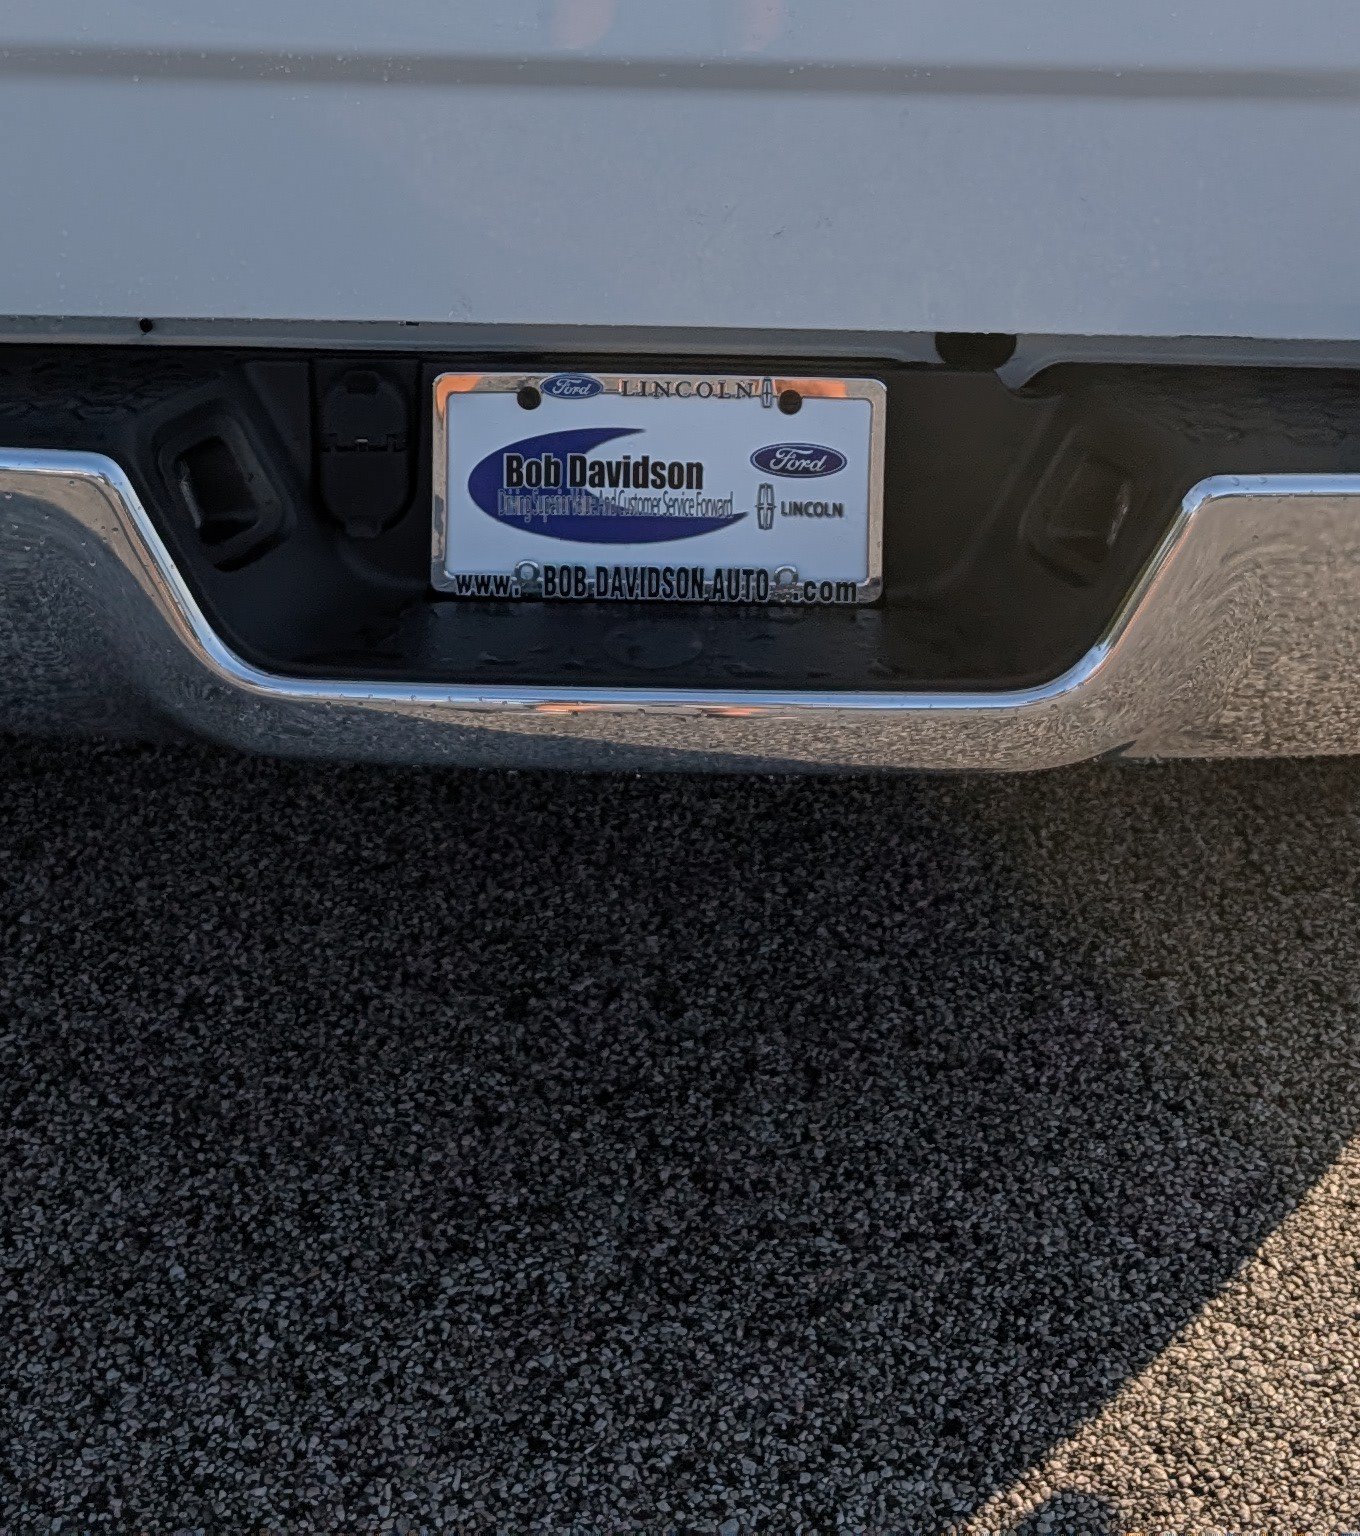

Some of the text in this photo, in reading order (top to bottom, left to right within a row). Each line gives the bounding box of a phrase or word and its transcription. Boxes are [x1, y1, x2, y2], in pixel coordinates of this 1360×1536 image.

[619, 378, 754, 399] LINCOLN
[504, 453, 704, 490] Bob Davidson
[769, 447, 827, 473] Ford
[618, 489, 662, 517] Customer
[663, 490, 695, 517] Service
[696, 490, 734, 518] Forward
[780, 500, 844, 519] LINCOLN
